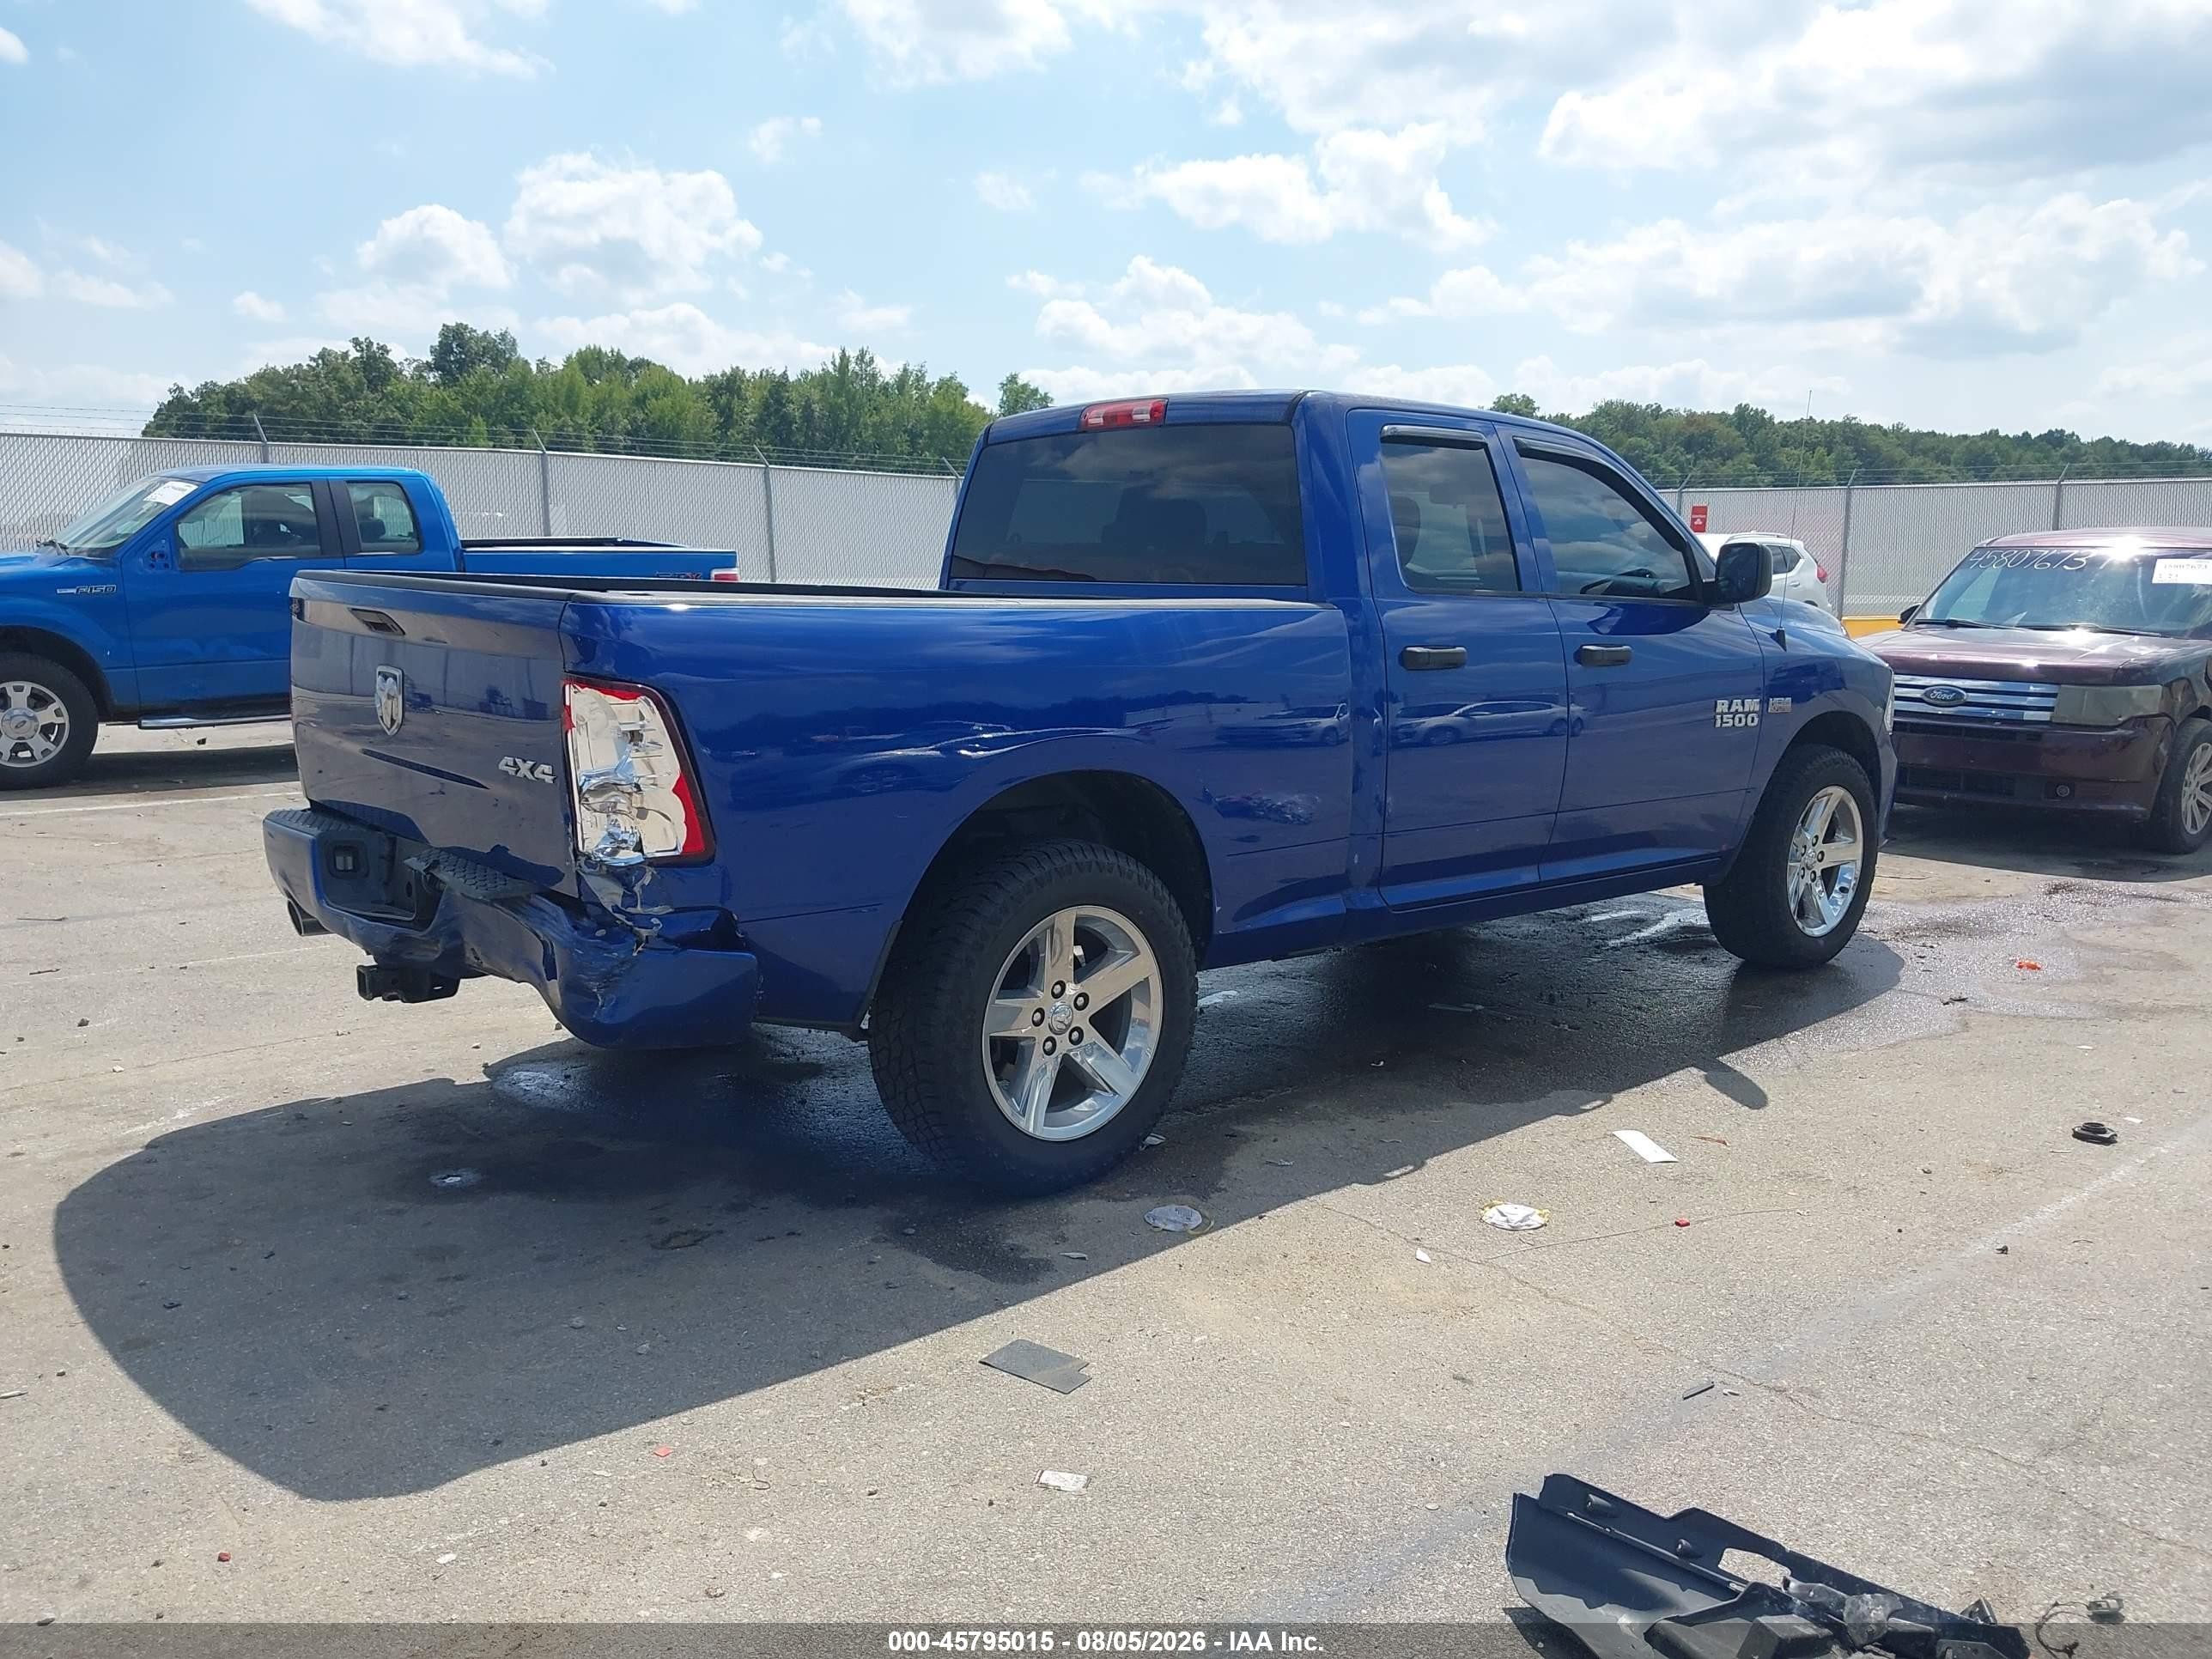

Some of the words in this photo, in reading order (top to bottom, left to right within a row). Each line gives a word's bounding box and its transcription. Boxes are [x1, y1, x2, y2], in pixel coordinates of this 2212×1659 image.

[1969, 549, 2096, 570] 45807673
[1929, 689, 1957, 700] Ford
[1716, 699, 1760, 713] RAM
[1715, 713, 1759, 728] 1500
